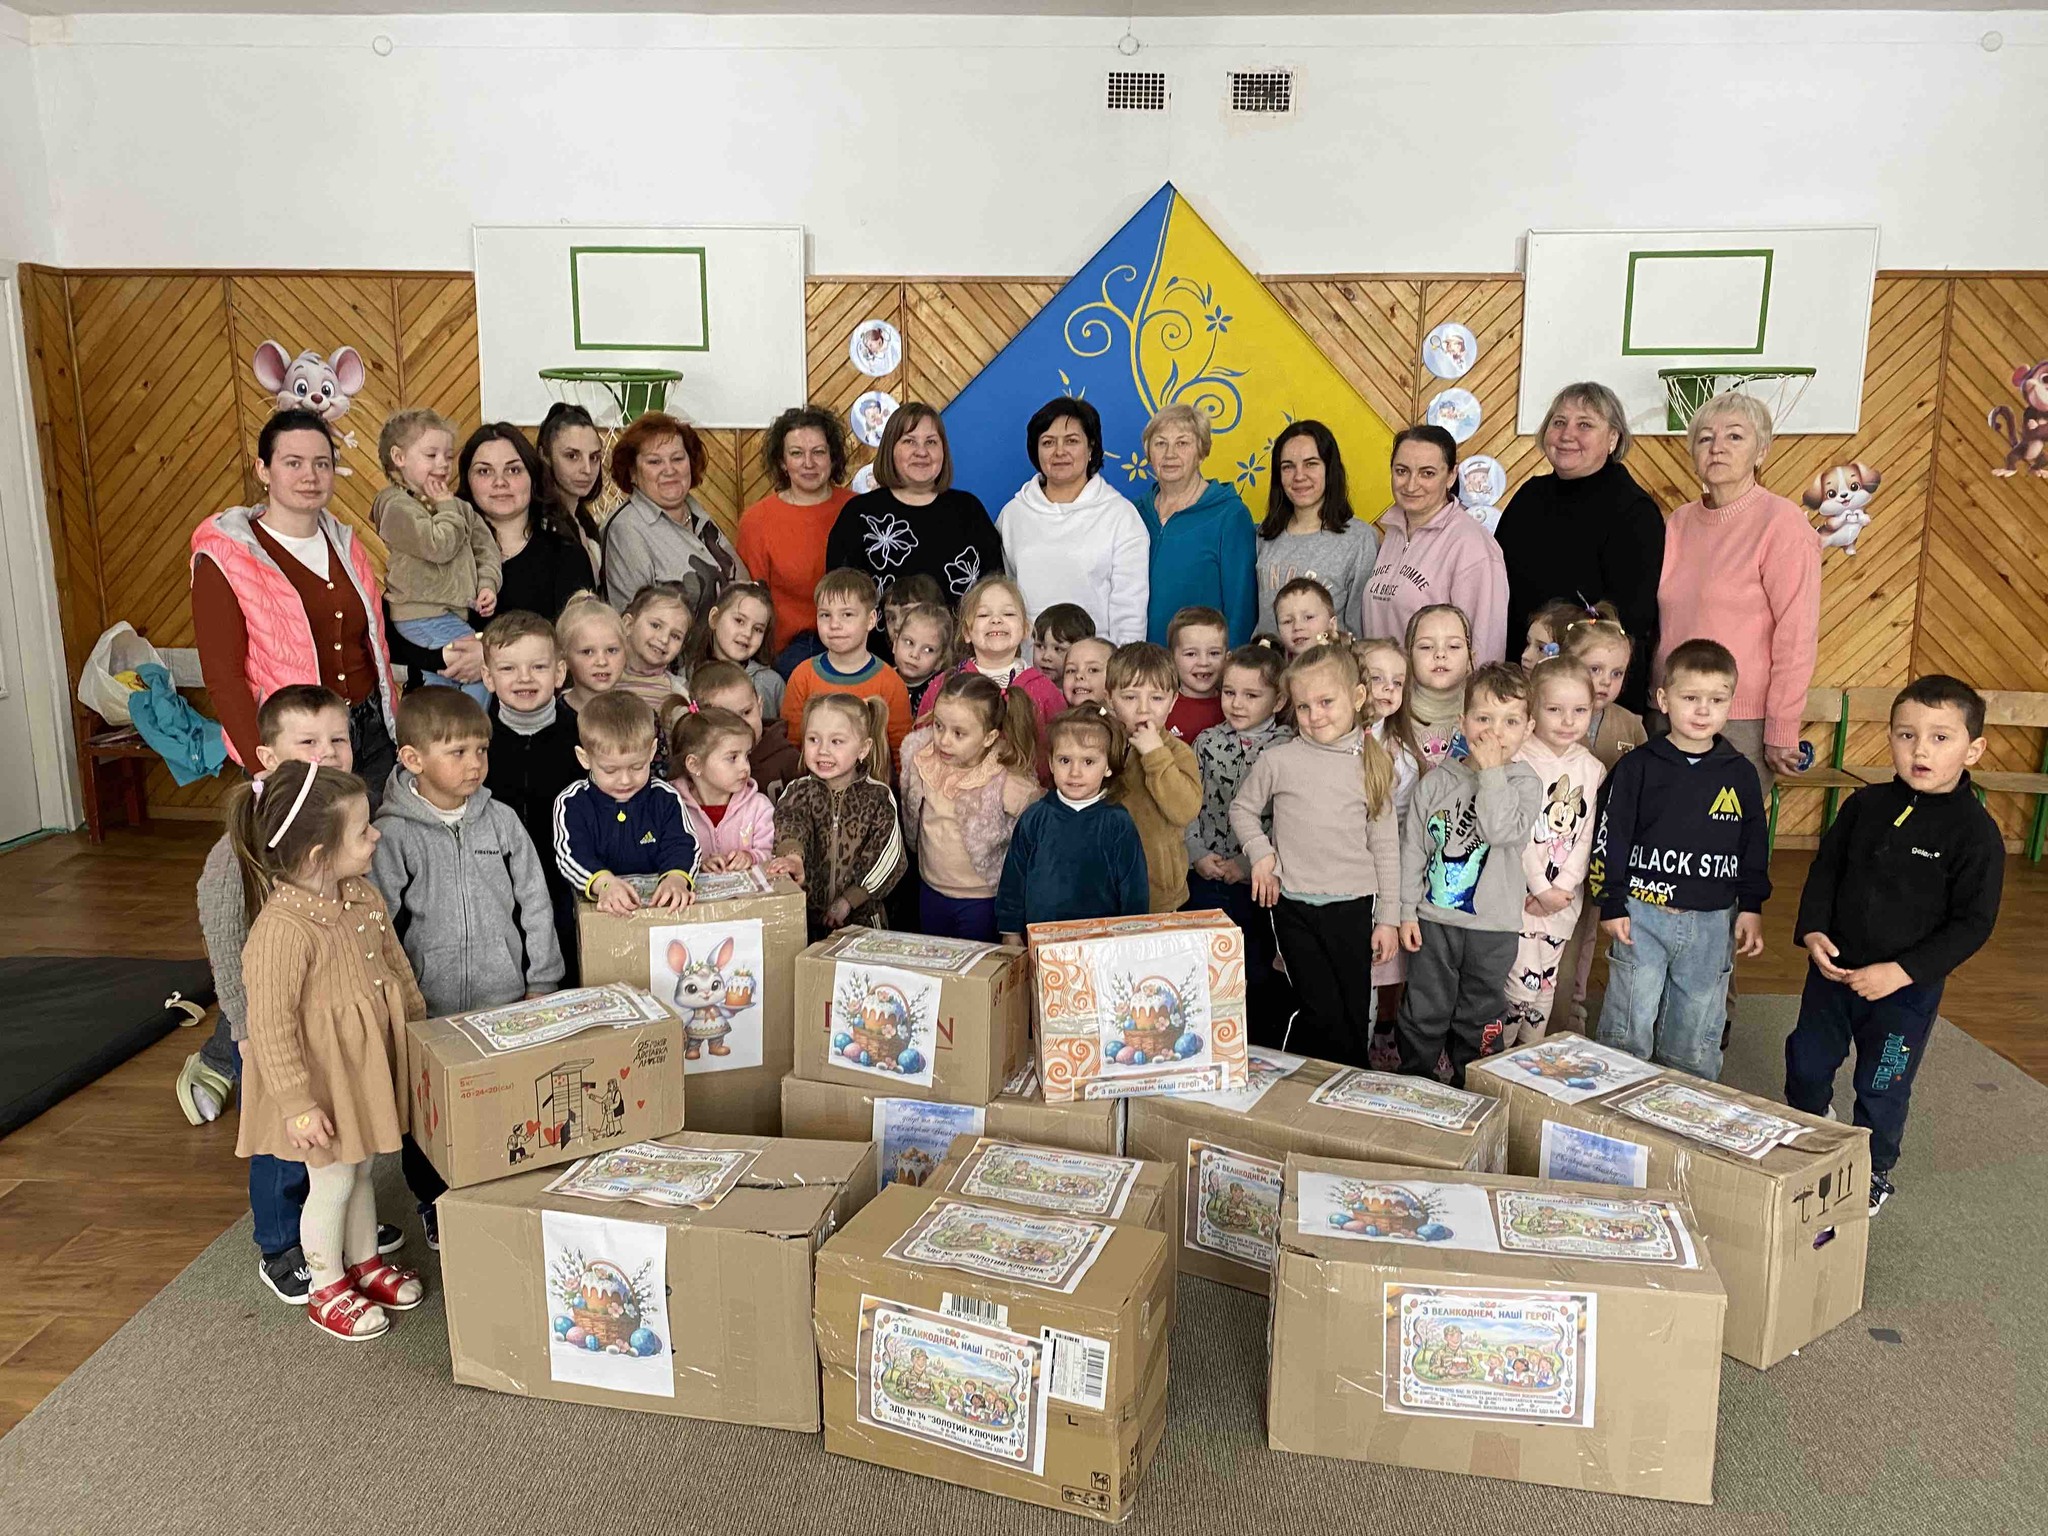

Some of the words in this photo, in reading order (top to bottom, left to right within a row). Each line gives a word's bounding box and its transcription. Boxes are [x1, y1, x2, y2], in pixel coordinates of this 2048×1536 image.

[1370, 582, 1380, 594] LA
[1400, 564, 1430, 592] COMME
[1712, 813, 1739, 822] MAFIA
[1629, 845, 1693, 876] BLACK
[1699, 853, 1738, 878] STAR
[1629, 875, 1677, 900] BLACK
[1631, 889, 1668, 905] STAR
[1422, 1308, 1428, 1316] З
[1431, 1307, 1496, 1320] ВЕЛИКОДНЕМ,
[1498, 1310, 1522, 1320] НАШІ
[1525, 1311, 1555, 1322] ГЕРОЇ!
[892, 1323, 899, 1334] З
[901, 1325, 959, 1349] ВЕЛИКОДНЕМ,
[961, 1341, 983, 1355] НАШІ
[985, 1347, 1013, 1363] ГЕРОЇ!
[890, 1403, 905, 1415] ЗДО
[918, 1412, 926, 1421] 14
[928, 1415, 967, 1435] "ЗОЛОТИЙ
[969, 1428, 1008, 1444] КЛЮЧИК"
